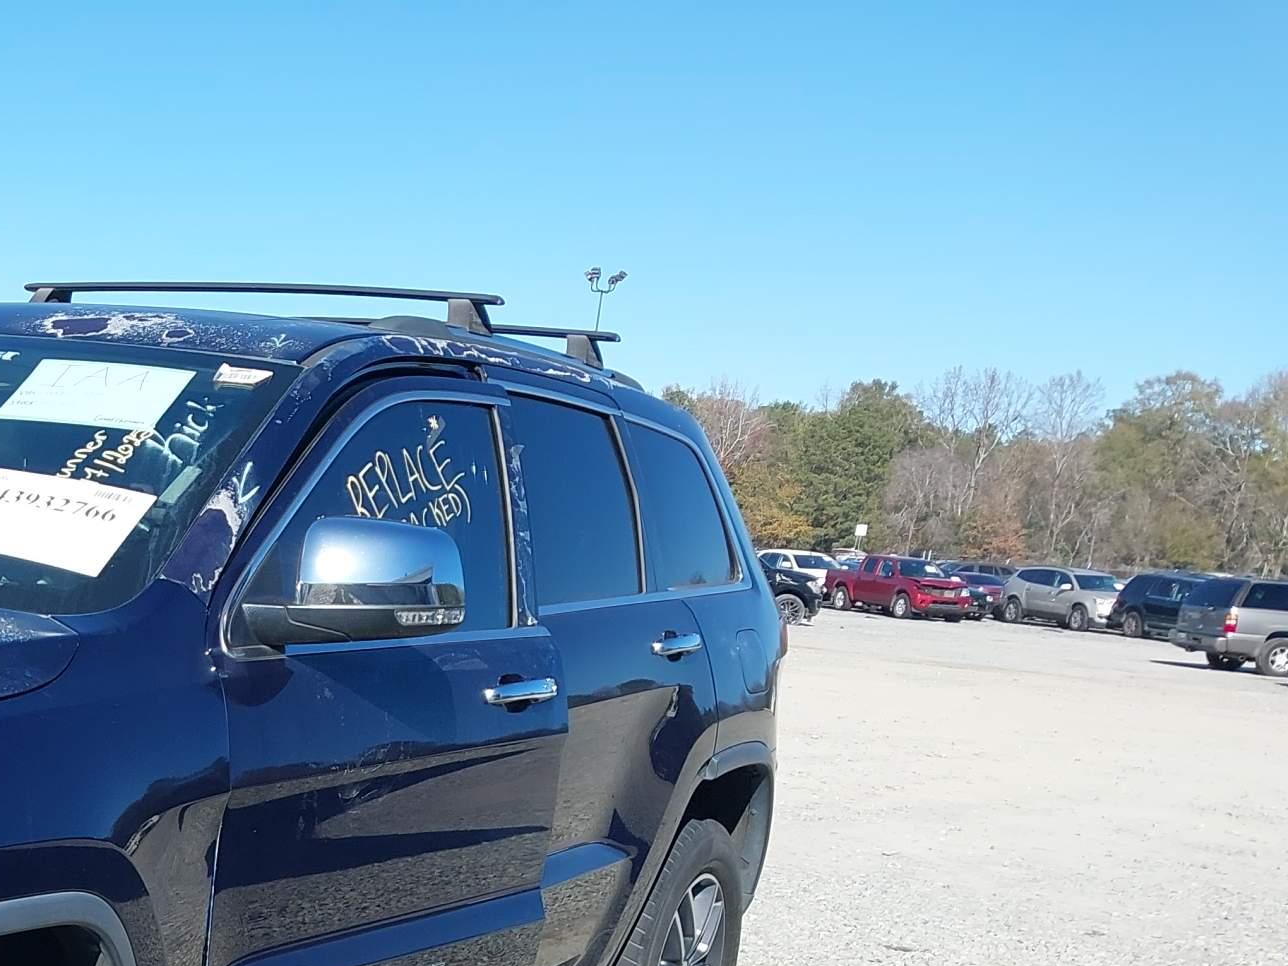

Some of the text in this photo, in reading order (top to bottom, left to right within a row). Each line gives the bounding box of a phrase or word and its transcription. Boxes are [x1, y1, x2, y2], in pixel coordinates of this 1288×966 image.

[50, 363, 150, 392] IAA
[56, 430, 107, 478] unner
[347, 441, 465, 518] REPLACE
